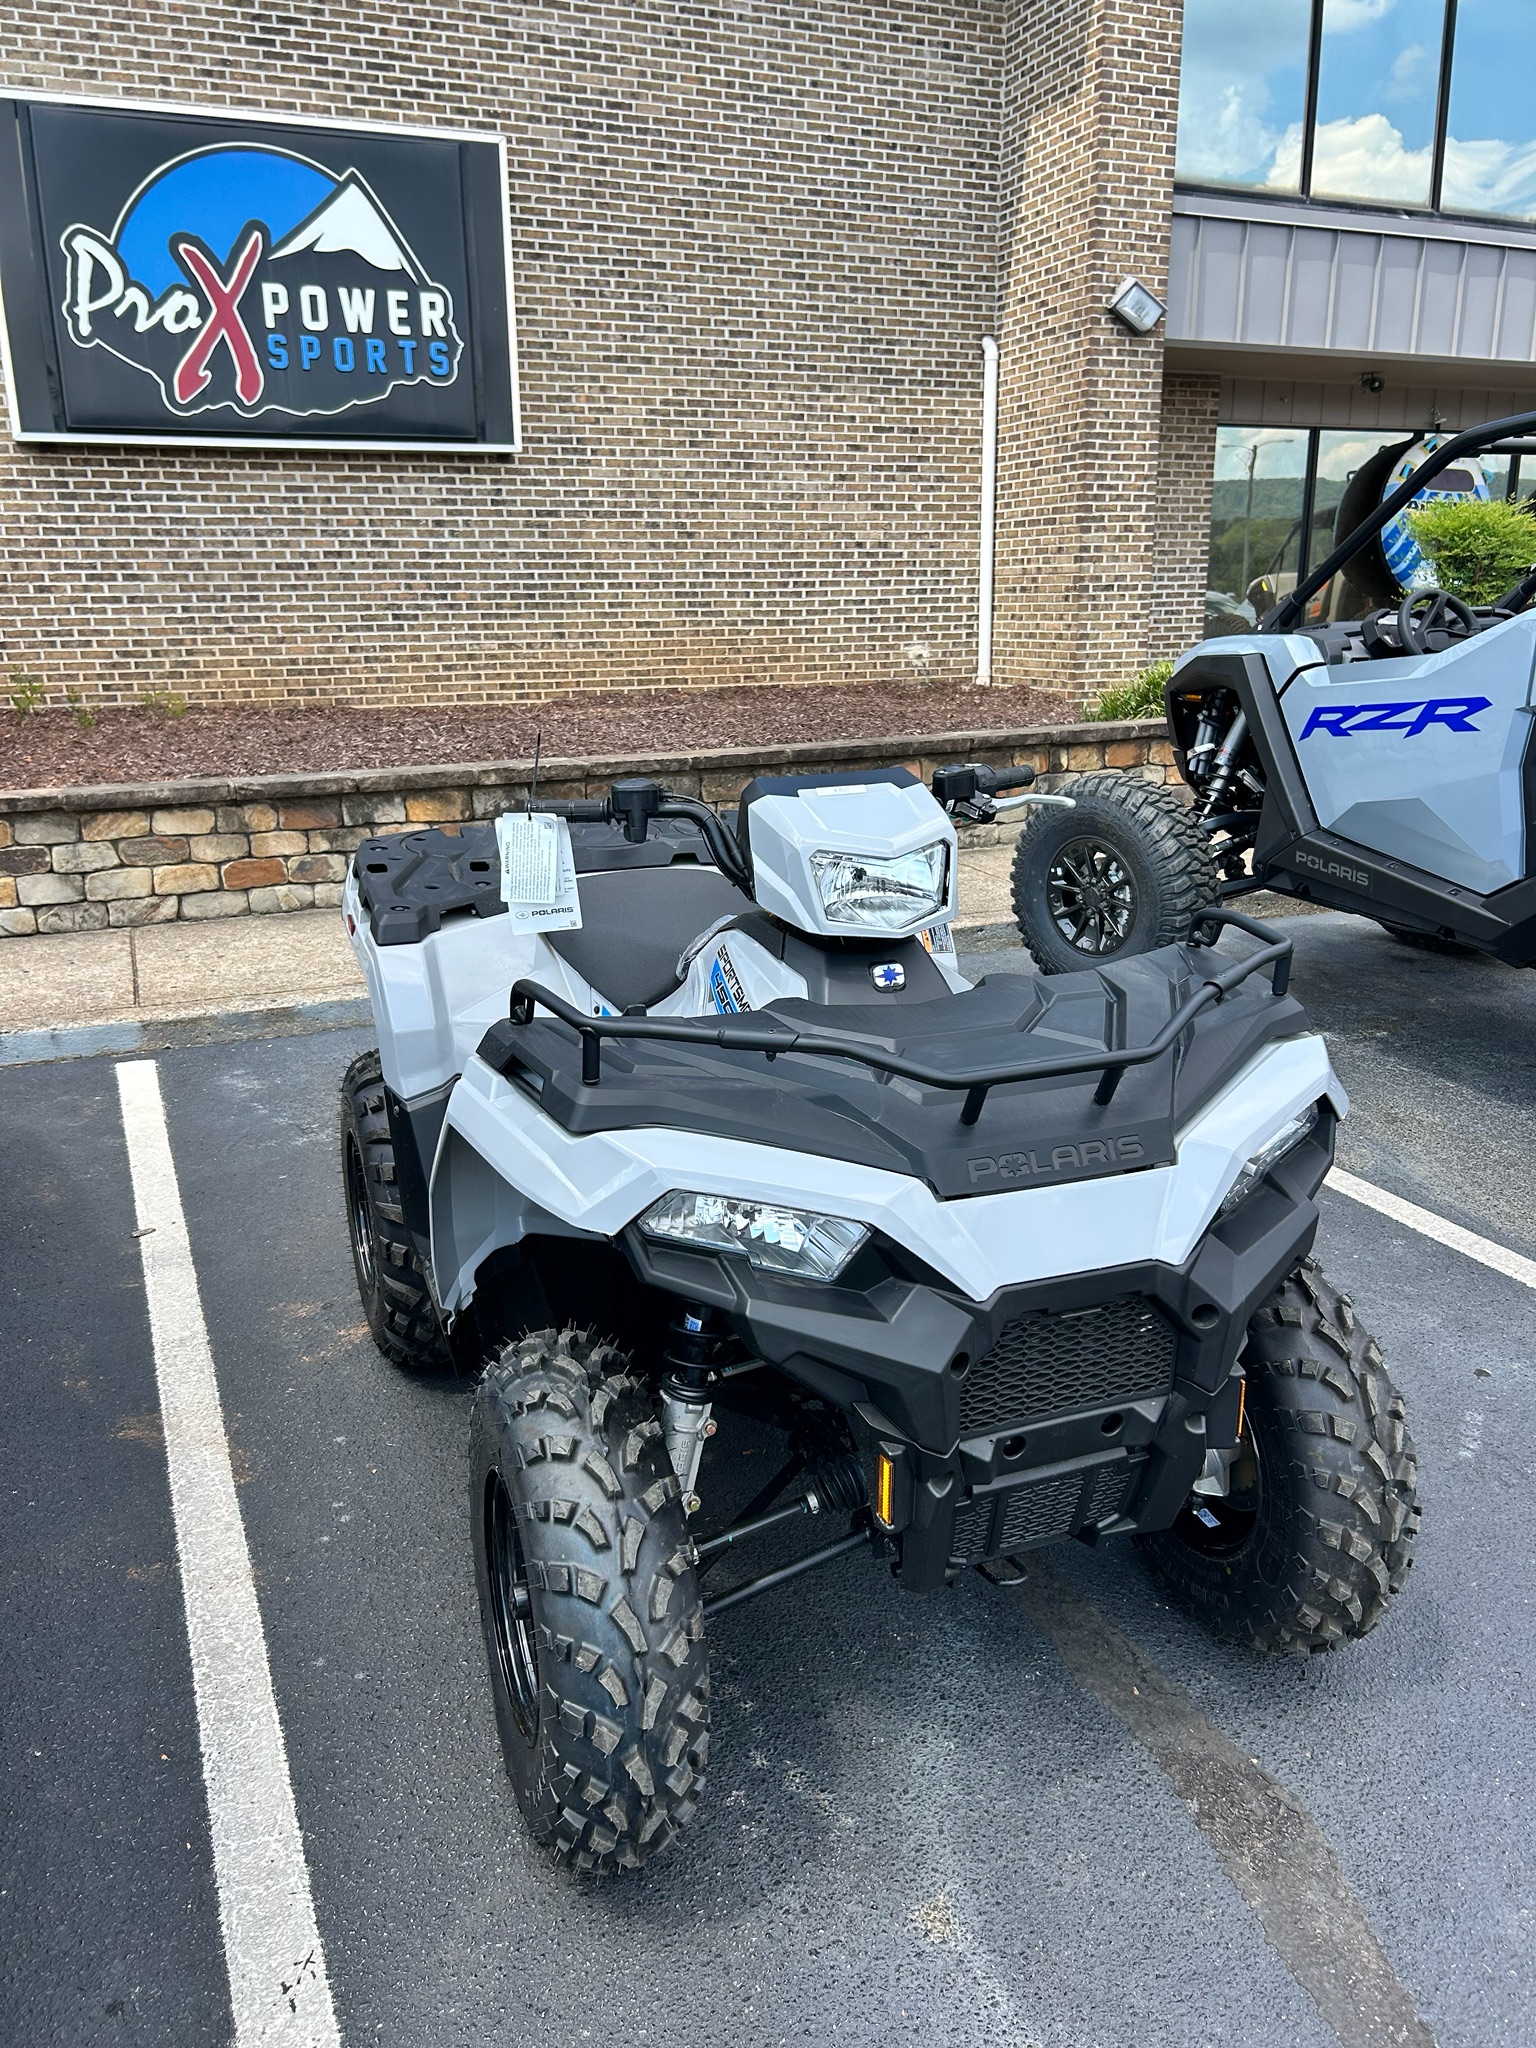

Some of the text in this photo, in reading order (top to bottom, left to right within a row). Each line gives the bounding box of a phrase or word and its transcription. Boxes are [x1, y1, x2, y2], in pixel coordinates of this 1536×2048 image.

[262, 282, 448, 338] POWER
[268, 334, 450, 376] SPORTS
[1298, 696, 1493, 742] RZR
[1295, 850, 1369, 886] POLARIS
[531, 906, 574, 917] POLARIS
[717, 943, 753, 1013] SPORTSM
[966, 1133, 1145, 1184] POLARIS
